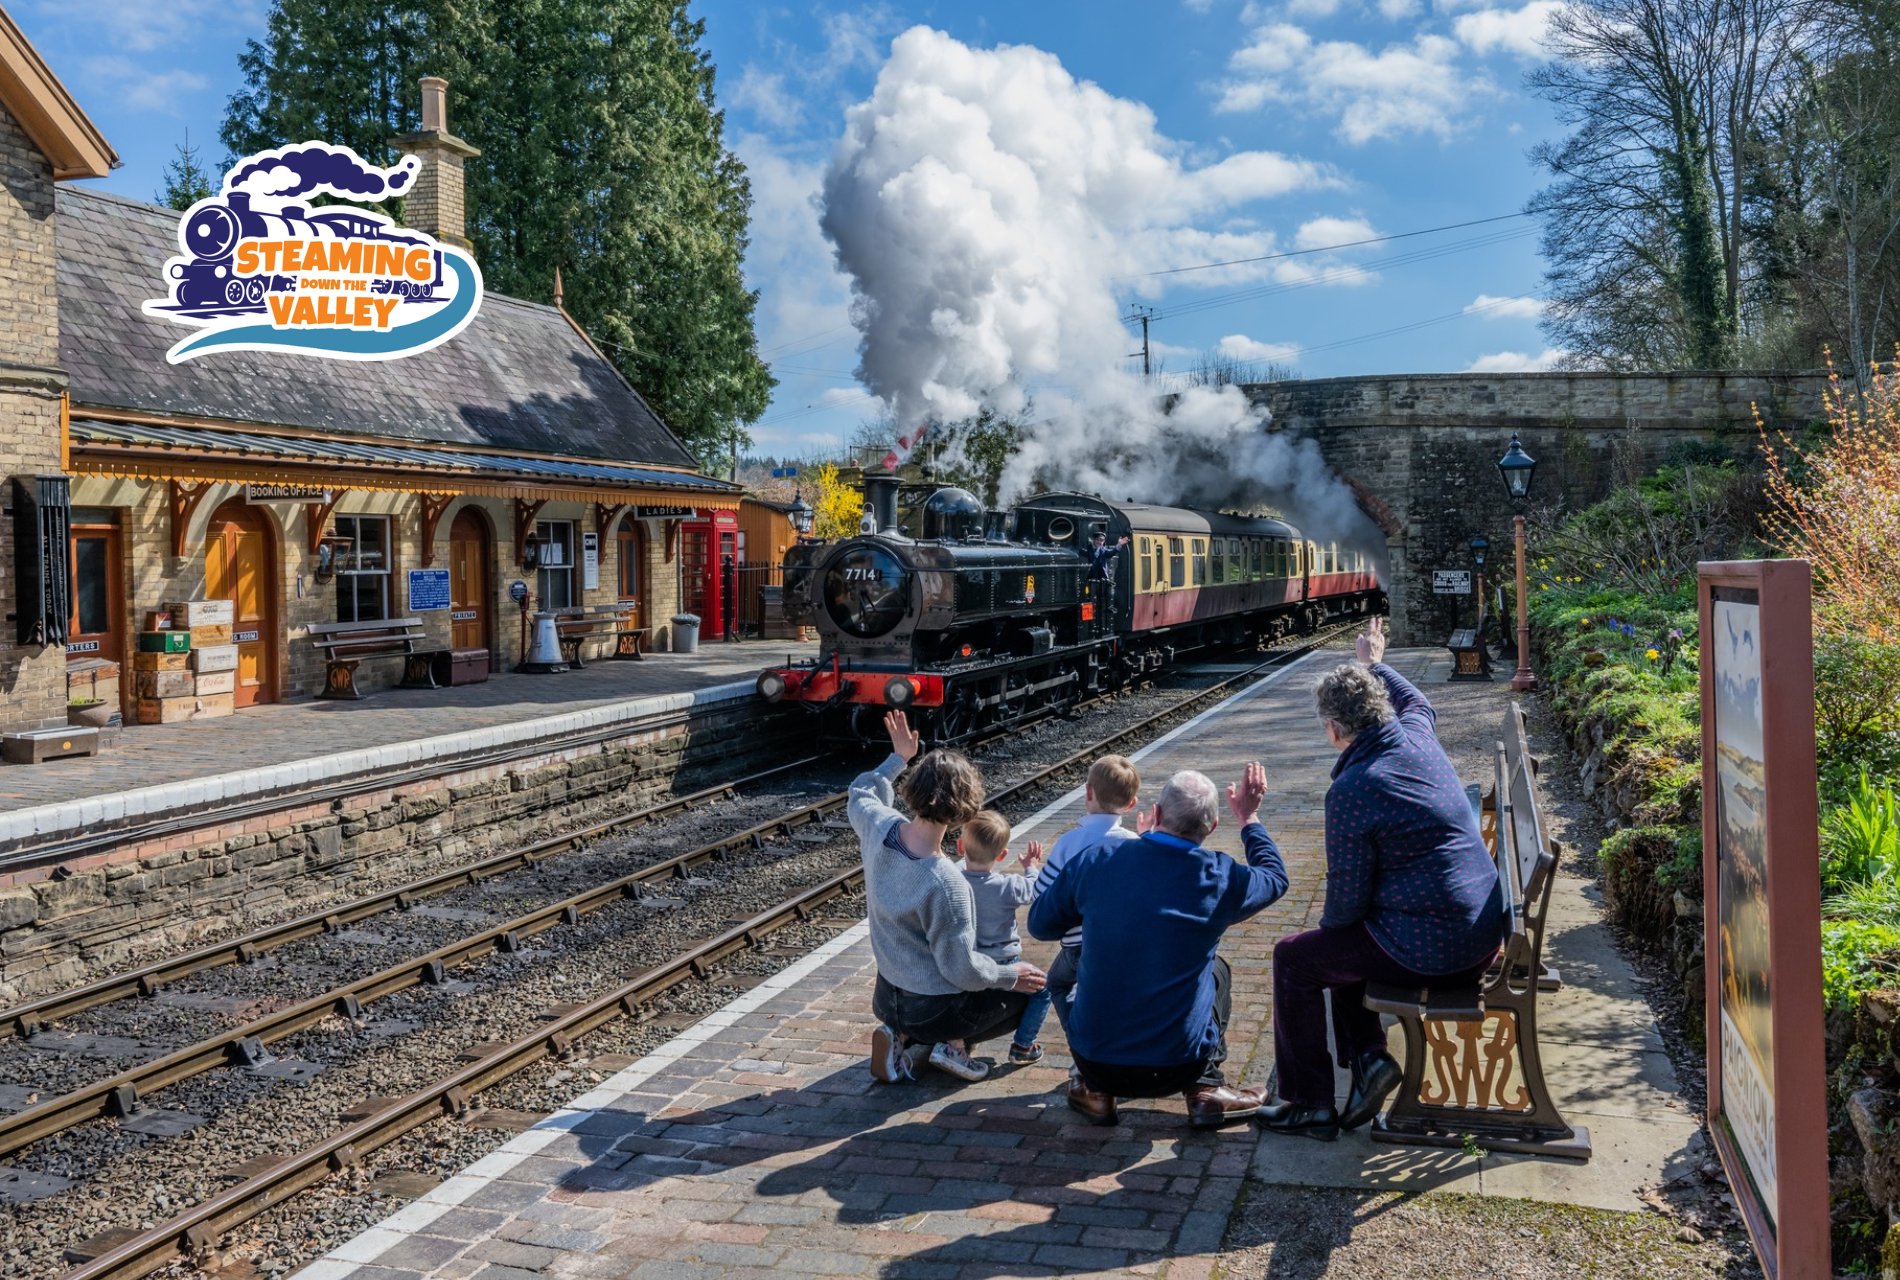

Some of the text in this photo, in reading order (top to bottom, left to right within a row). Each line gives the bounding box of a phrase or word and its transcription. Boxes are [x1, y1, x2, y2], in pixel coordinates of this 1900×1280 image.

[251, 486, 322, 497] BOOKING OFFICE
[646, 507, 683, 516] LADIES
[845, 568, 876, 581] 7714
[45, 587, 53, 614] TODAY
[240, 632, 256, 640] ROOM
[66, 644, 96, 652] ORTERS
[330, 667, 350, 689] GWR
[1724, 1020, 1768, 1142] PAIGNTON
